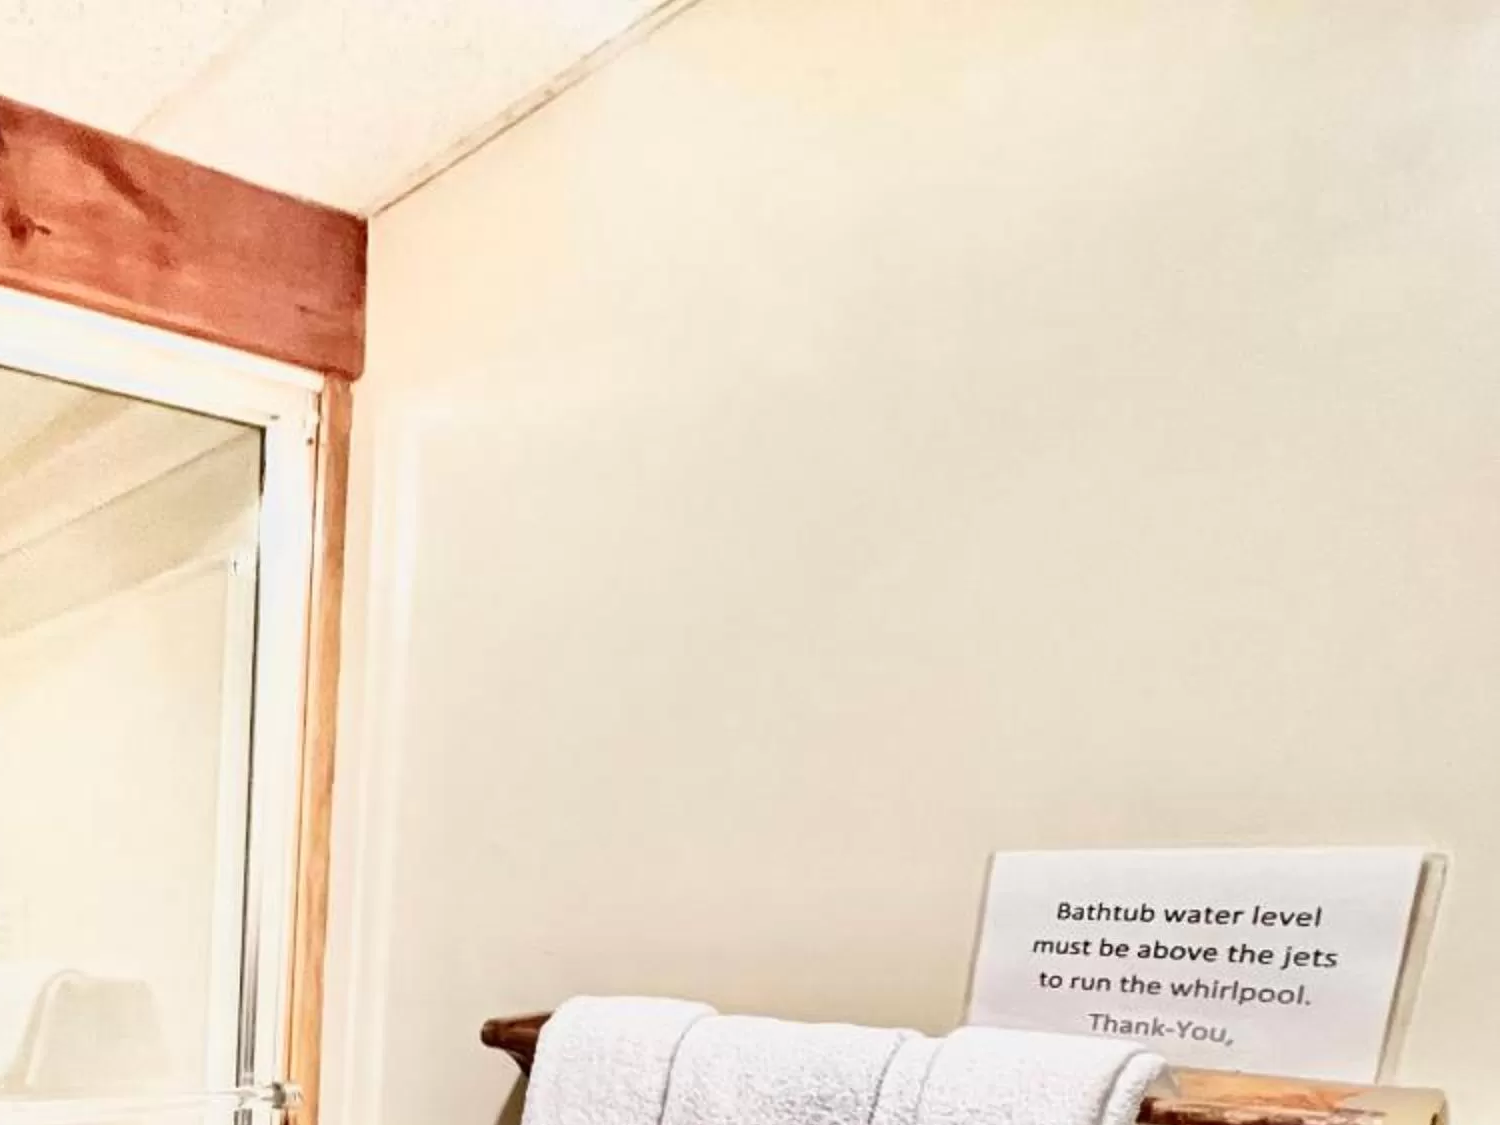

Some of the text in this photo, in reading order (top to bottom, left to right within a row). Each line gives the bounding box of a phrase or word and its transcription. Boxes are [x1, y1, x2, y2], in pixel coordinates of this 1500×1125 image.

[1056, 901, 1323, 928] Bathtub water level
[1032, 937, 1339, 971] must be above the jets
[1039, 971, 1312, 1007] to run the whirlpool.
[1088, 1012, 1235, 1046] Thank-You,
